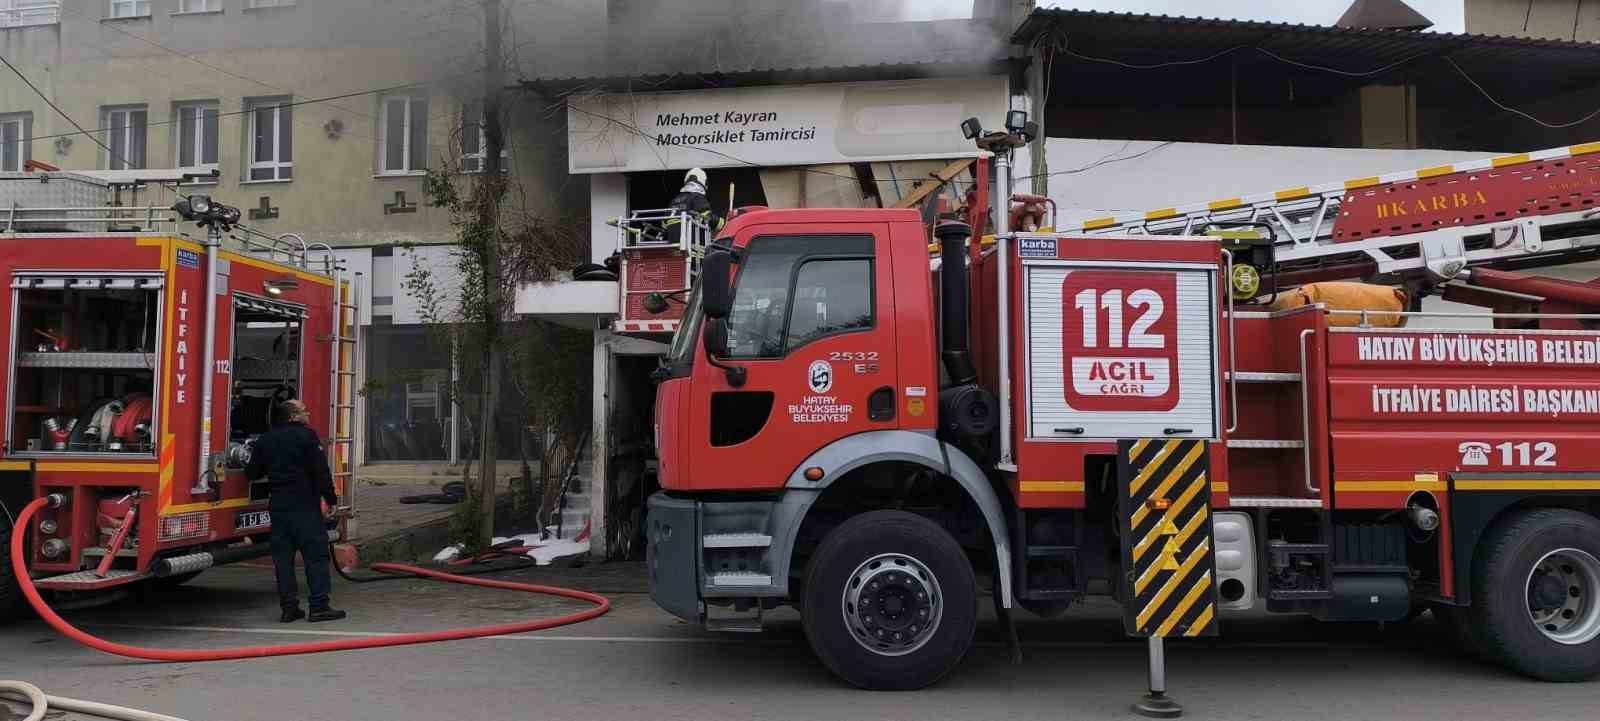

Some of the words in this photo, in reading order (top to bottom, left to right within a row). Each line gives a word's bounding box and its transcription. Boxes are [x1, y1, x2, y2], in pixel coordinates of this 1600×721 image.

[656, 112, 721, 127] Mehmet
[724, 111, 777, 126] Kayran
[656, 130, 745, 146] Motorsiklet
[751, 127, 816, 142] Tamircisi
[1021, 239, 1055, 249] karba
[1075, 288, 1165, 348] 112
[829, 351, 879, 361] 2532
[1358, 336, 1415, 361] HATAY
[1420, 334, 1538, 366] BÜYÜKŞEHİR
[215, 359, 230, 374] 112
[803, 396, 838, 405] HATAY
[1372, 385, 1442, 413] İTFAİYE
[1446, 385, 1520, 413] DAİRESİ
[1524, 387, 1600, 418] BAŞKAN
[1496, 441, 1557, 466] 112
